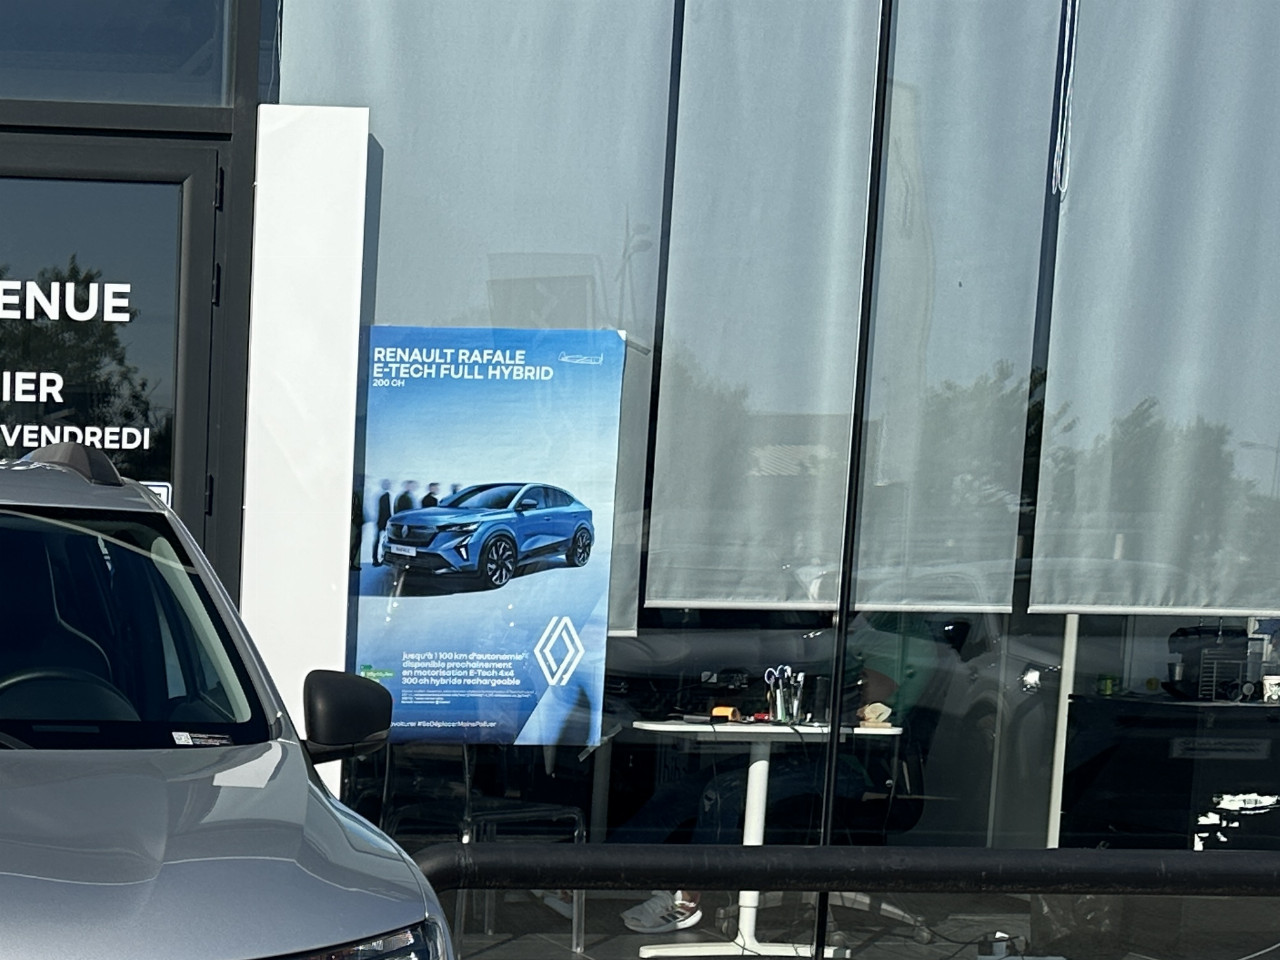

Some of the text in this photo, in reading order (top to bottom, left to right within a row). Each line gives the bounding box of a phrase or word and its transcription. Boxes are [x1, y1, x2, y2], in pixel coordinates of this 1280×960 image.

[373, 347, 526, 365] RENAULT RAFALE
[373, 363, 554, 381] E-TECH FULL HYBRID
[372, 379, 390, 387] 200
[0, 423, 151, 451] VENDREDI
[454, 652, 468, 660] km
[402, 660, 513, 669] disponible prochainement
[414, 669, 468, 677] motorisation
[401, 677, 418, 685] 300
[430, 677, 462, 687] hybride
[463, 677, 521, 687] rechargeable
